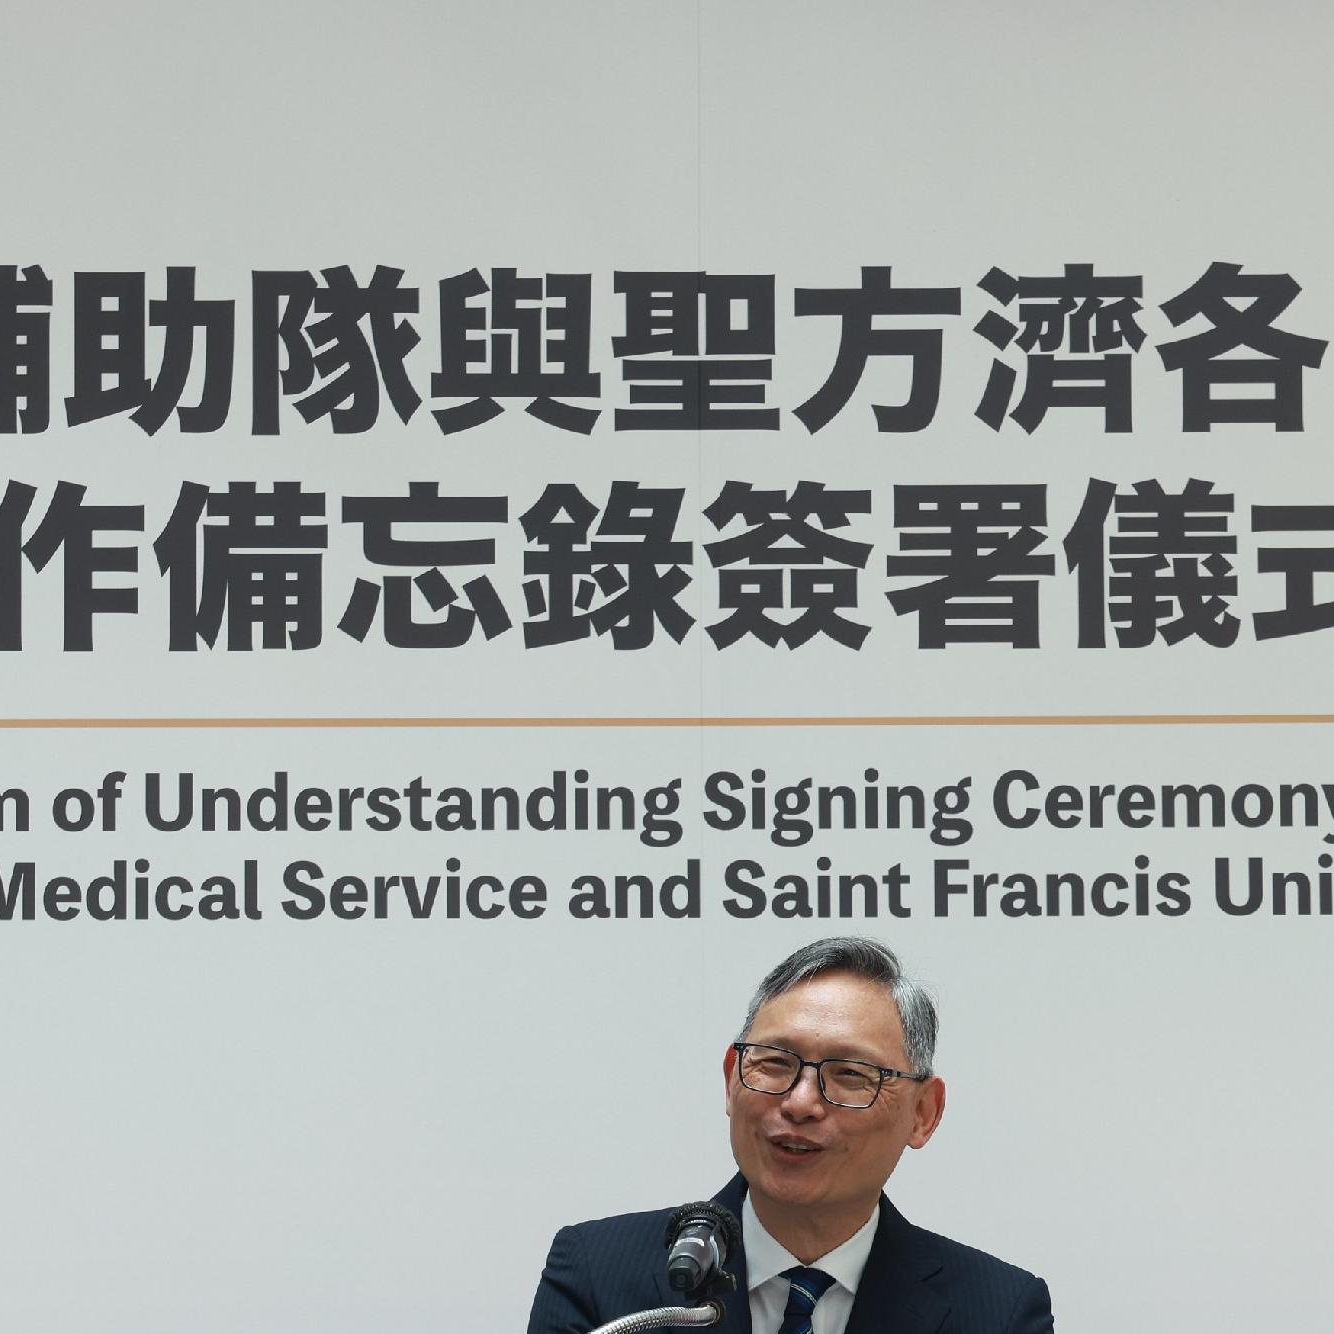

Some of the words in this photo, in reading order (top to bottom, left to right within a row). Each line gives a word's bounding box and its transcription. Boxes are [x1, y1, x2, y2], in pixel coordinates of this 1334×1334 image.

[52, 770, 128, 832] of
[145, 769, 683, 847] Understanding
[703, 767, 974, 848] Signing
[281, 857, 548, 921] Service
[568, 858, 701, 919] and
[722, 856, 912, 920] Saint
[933, 855, 1192, 918] Francis
